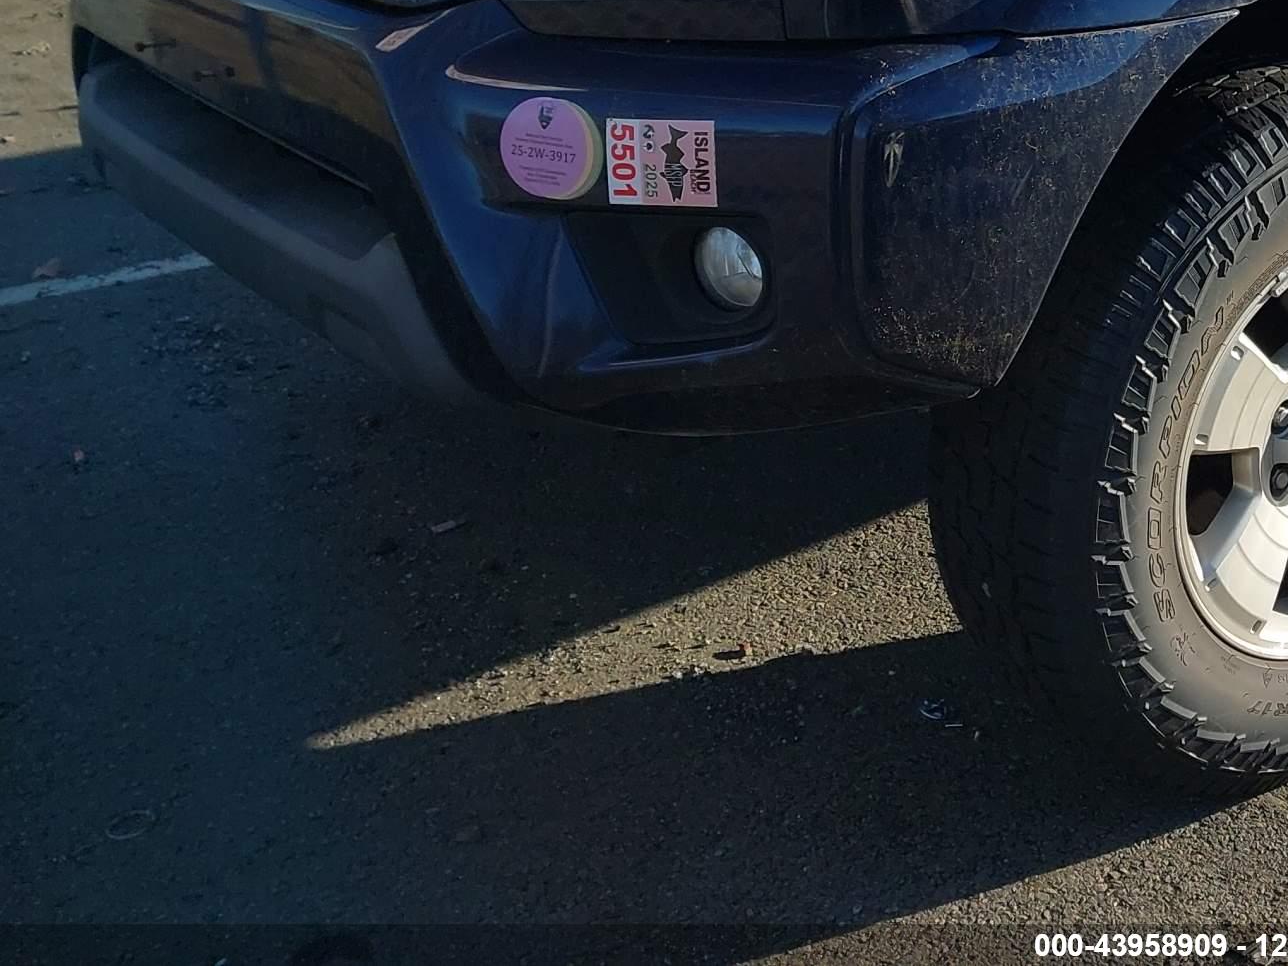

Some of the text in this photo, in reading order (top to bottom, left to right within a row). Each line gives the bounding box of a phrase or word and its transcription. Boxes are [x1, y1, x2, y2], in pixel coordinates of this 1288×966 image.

[511, 144, 576, 164] 25-2W-3917
[610, 122, 638, 197] 5501
[643, 163, 658, 198] 2025
[694, 131, 711, 192] ISLAND
[1147, 305, 1226, 622] SCORPION
